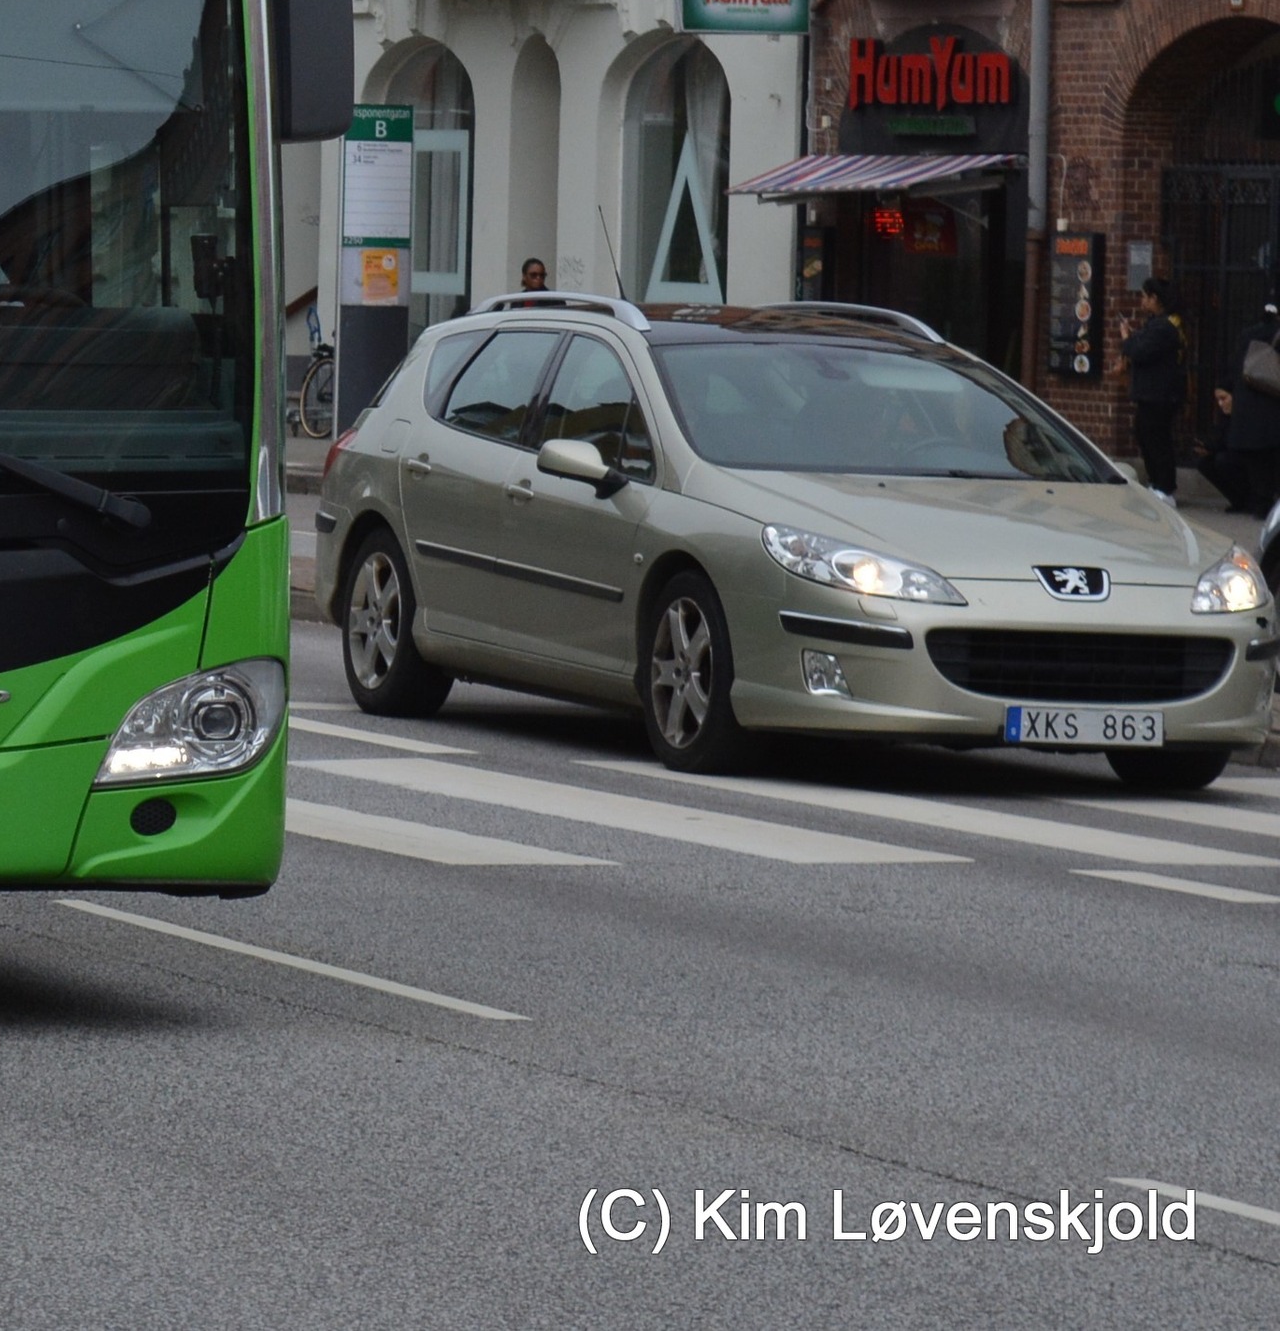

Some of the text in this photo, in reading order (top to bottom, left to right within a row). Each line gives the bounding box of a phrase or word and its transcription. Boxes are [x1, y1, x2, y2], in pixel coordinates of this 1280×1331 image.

[848, 35, 1012, 111] HumYum
[375, 120, 387, 138] B
[1025, 711, 1157, 742] XKS 863
